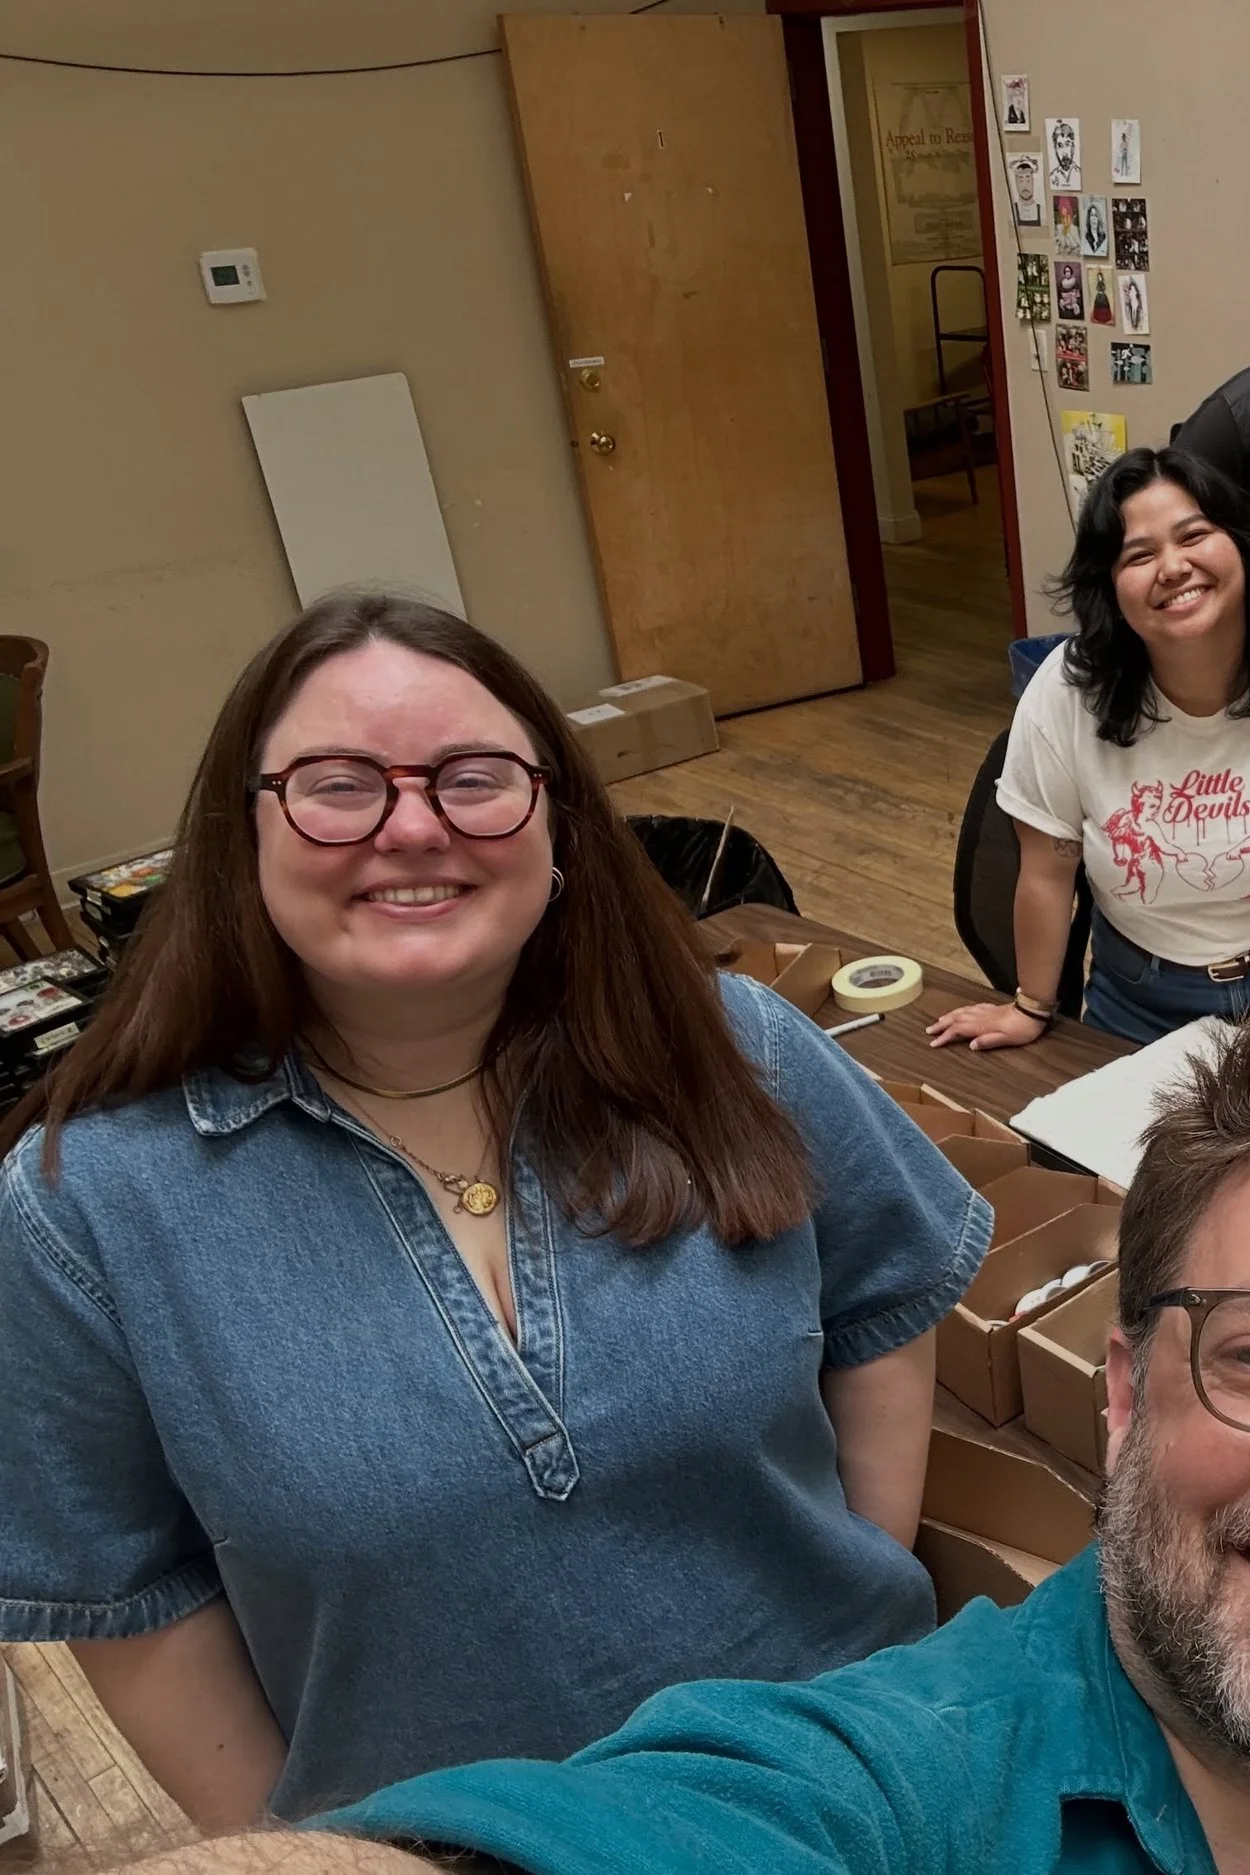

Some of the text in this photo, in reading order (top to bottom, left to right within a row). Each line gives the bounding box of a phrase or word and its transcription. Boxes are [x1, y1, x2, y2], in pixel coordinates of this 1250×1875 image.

[886, 128, 925, 150] Appeal
[929, 133, 941, 145] to
[1169, 768, 1246, 799] Little
[1163, 792, 1250, 824] Devils
